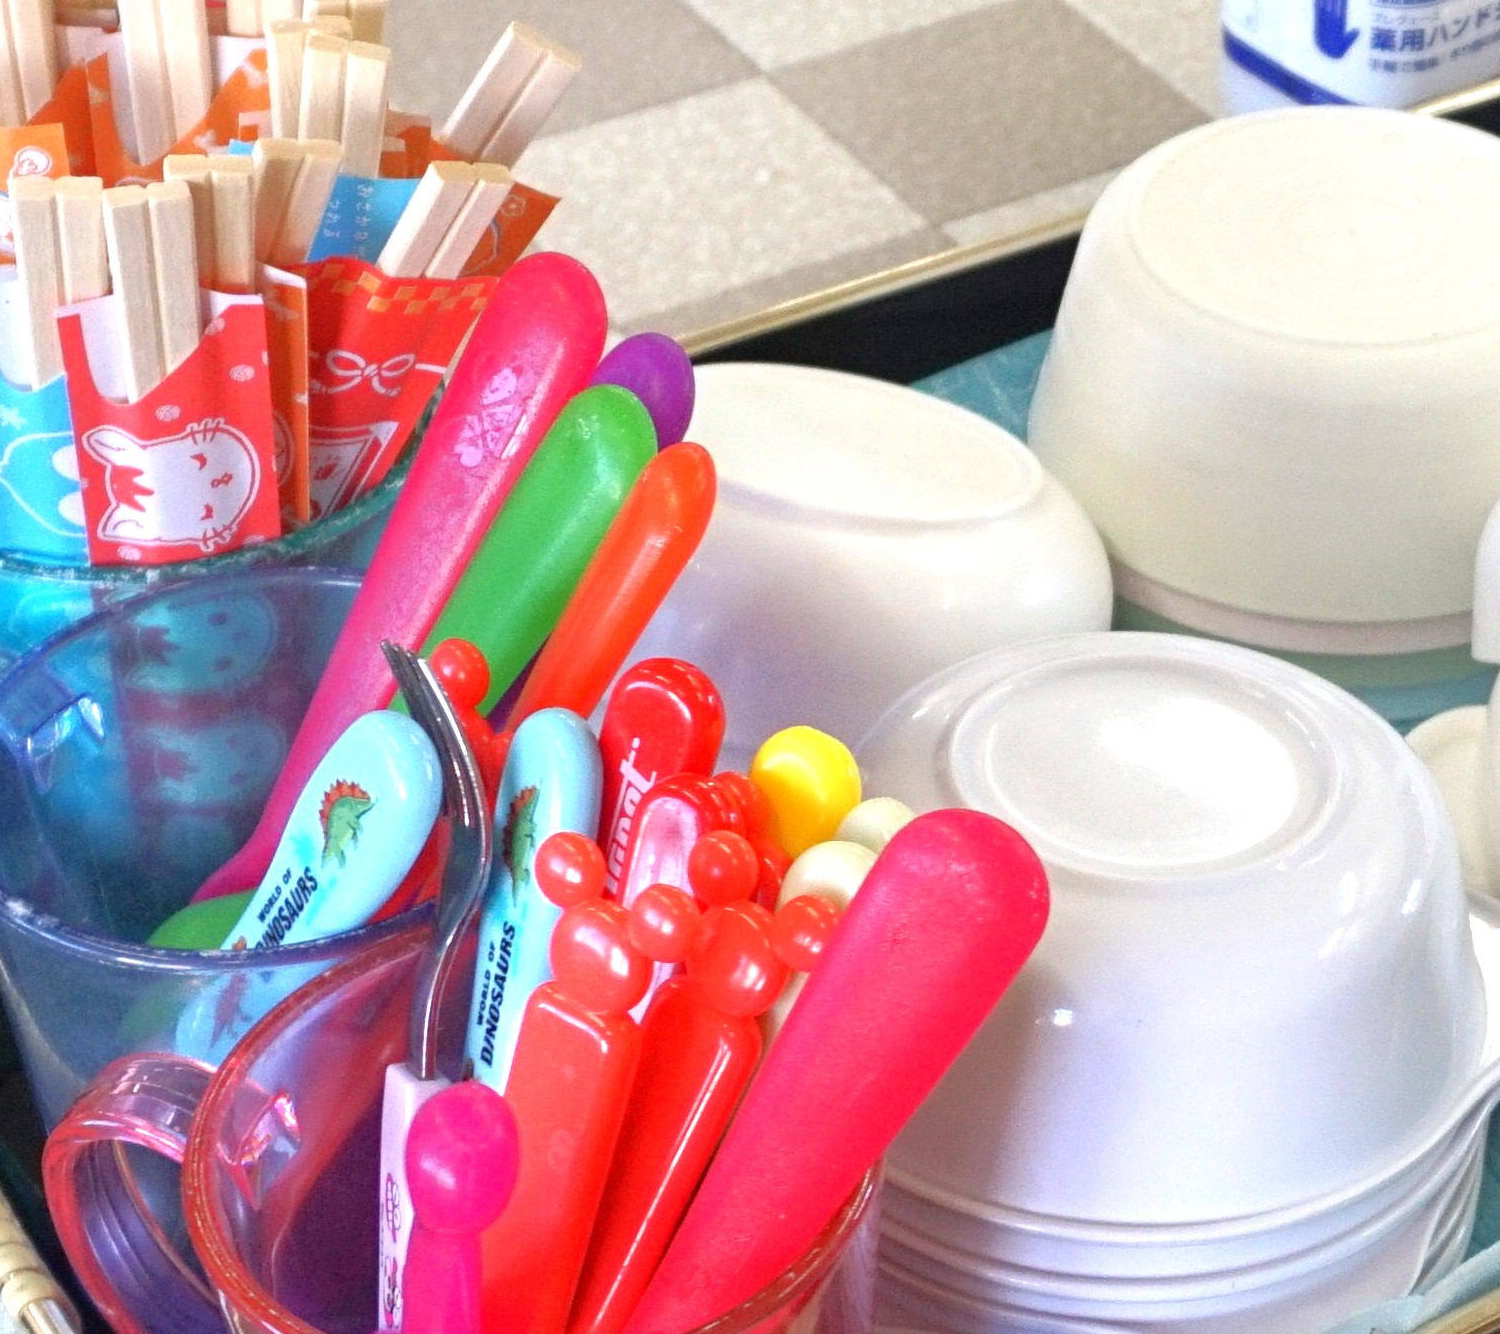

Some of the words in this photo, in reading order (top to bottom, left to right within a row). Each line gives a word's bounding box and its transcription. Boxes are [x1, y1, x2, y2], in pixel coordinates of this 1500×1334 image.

[257, 885, 282, 923] WORLD
[282, 867, 292, 885] OF
[477, 969, 491, 1026] WORLD
[488, 941, 496, 962] OF
[480, 921, 516, 1067] DINOSAURS
